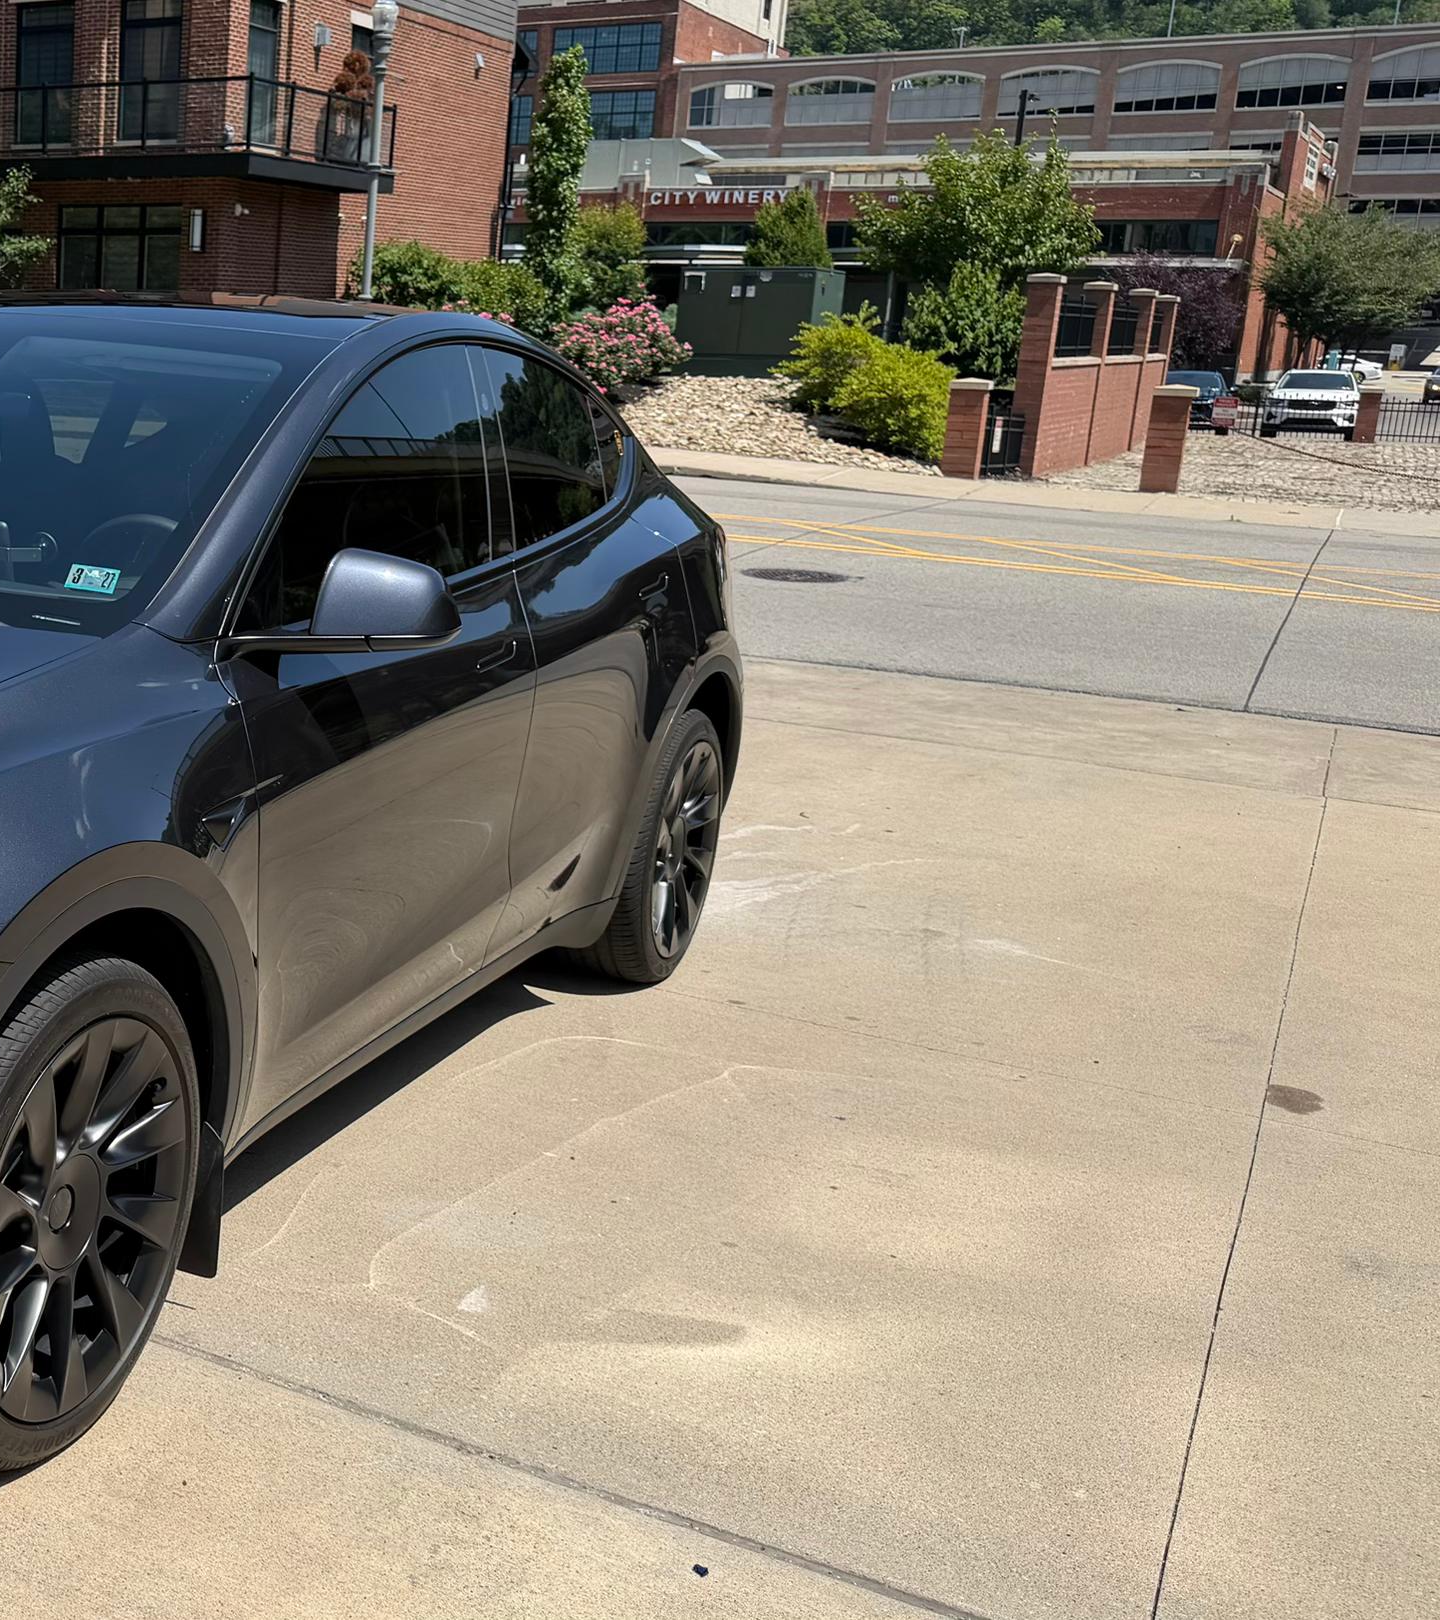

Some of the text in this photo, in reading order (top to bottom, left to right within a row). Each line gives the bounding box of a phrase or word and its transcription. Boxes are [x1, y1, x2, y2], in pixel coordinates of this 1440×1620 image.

[650, 189, 790, 206] CITY WINERY
[71, 567, 85, 584] 3
[101, 571, 116, 590] 27
